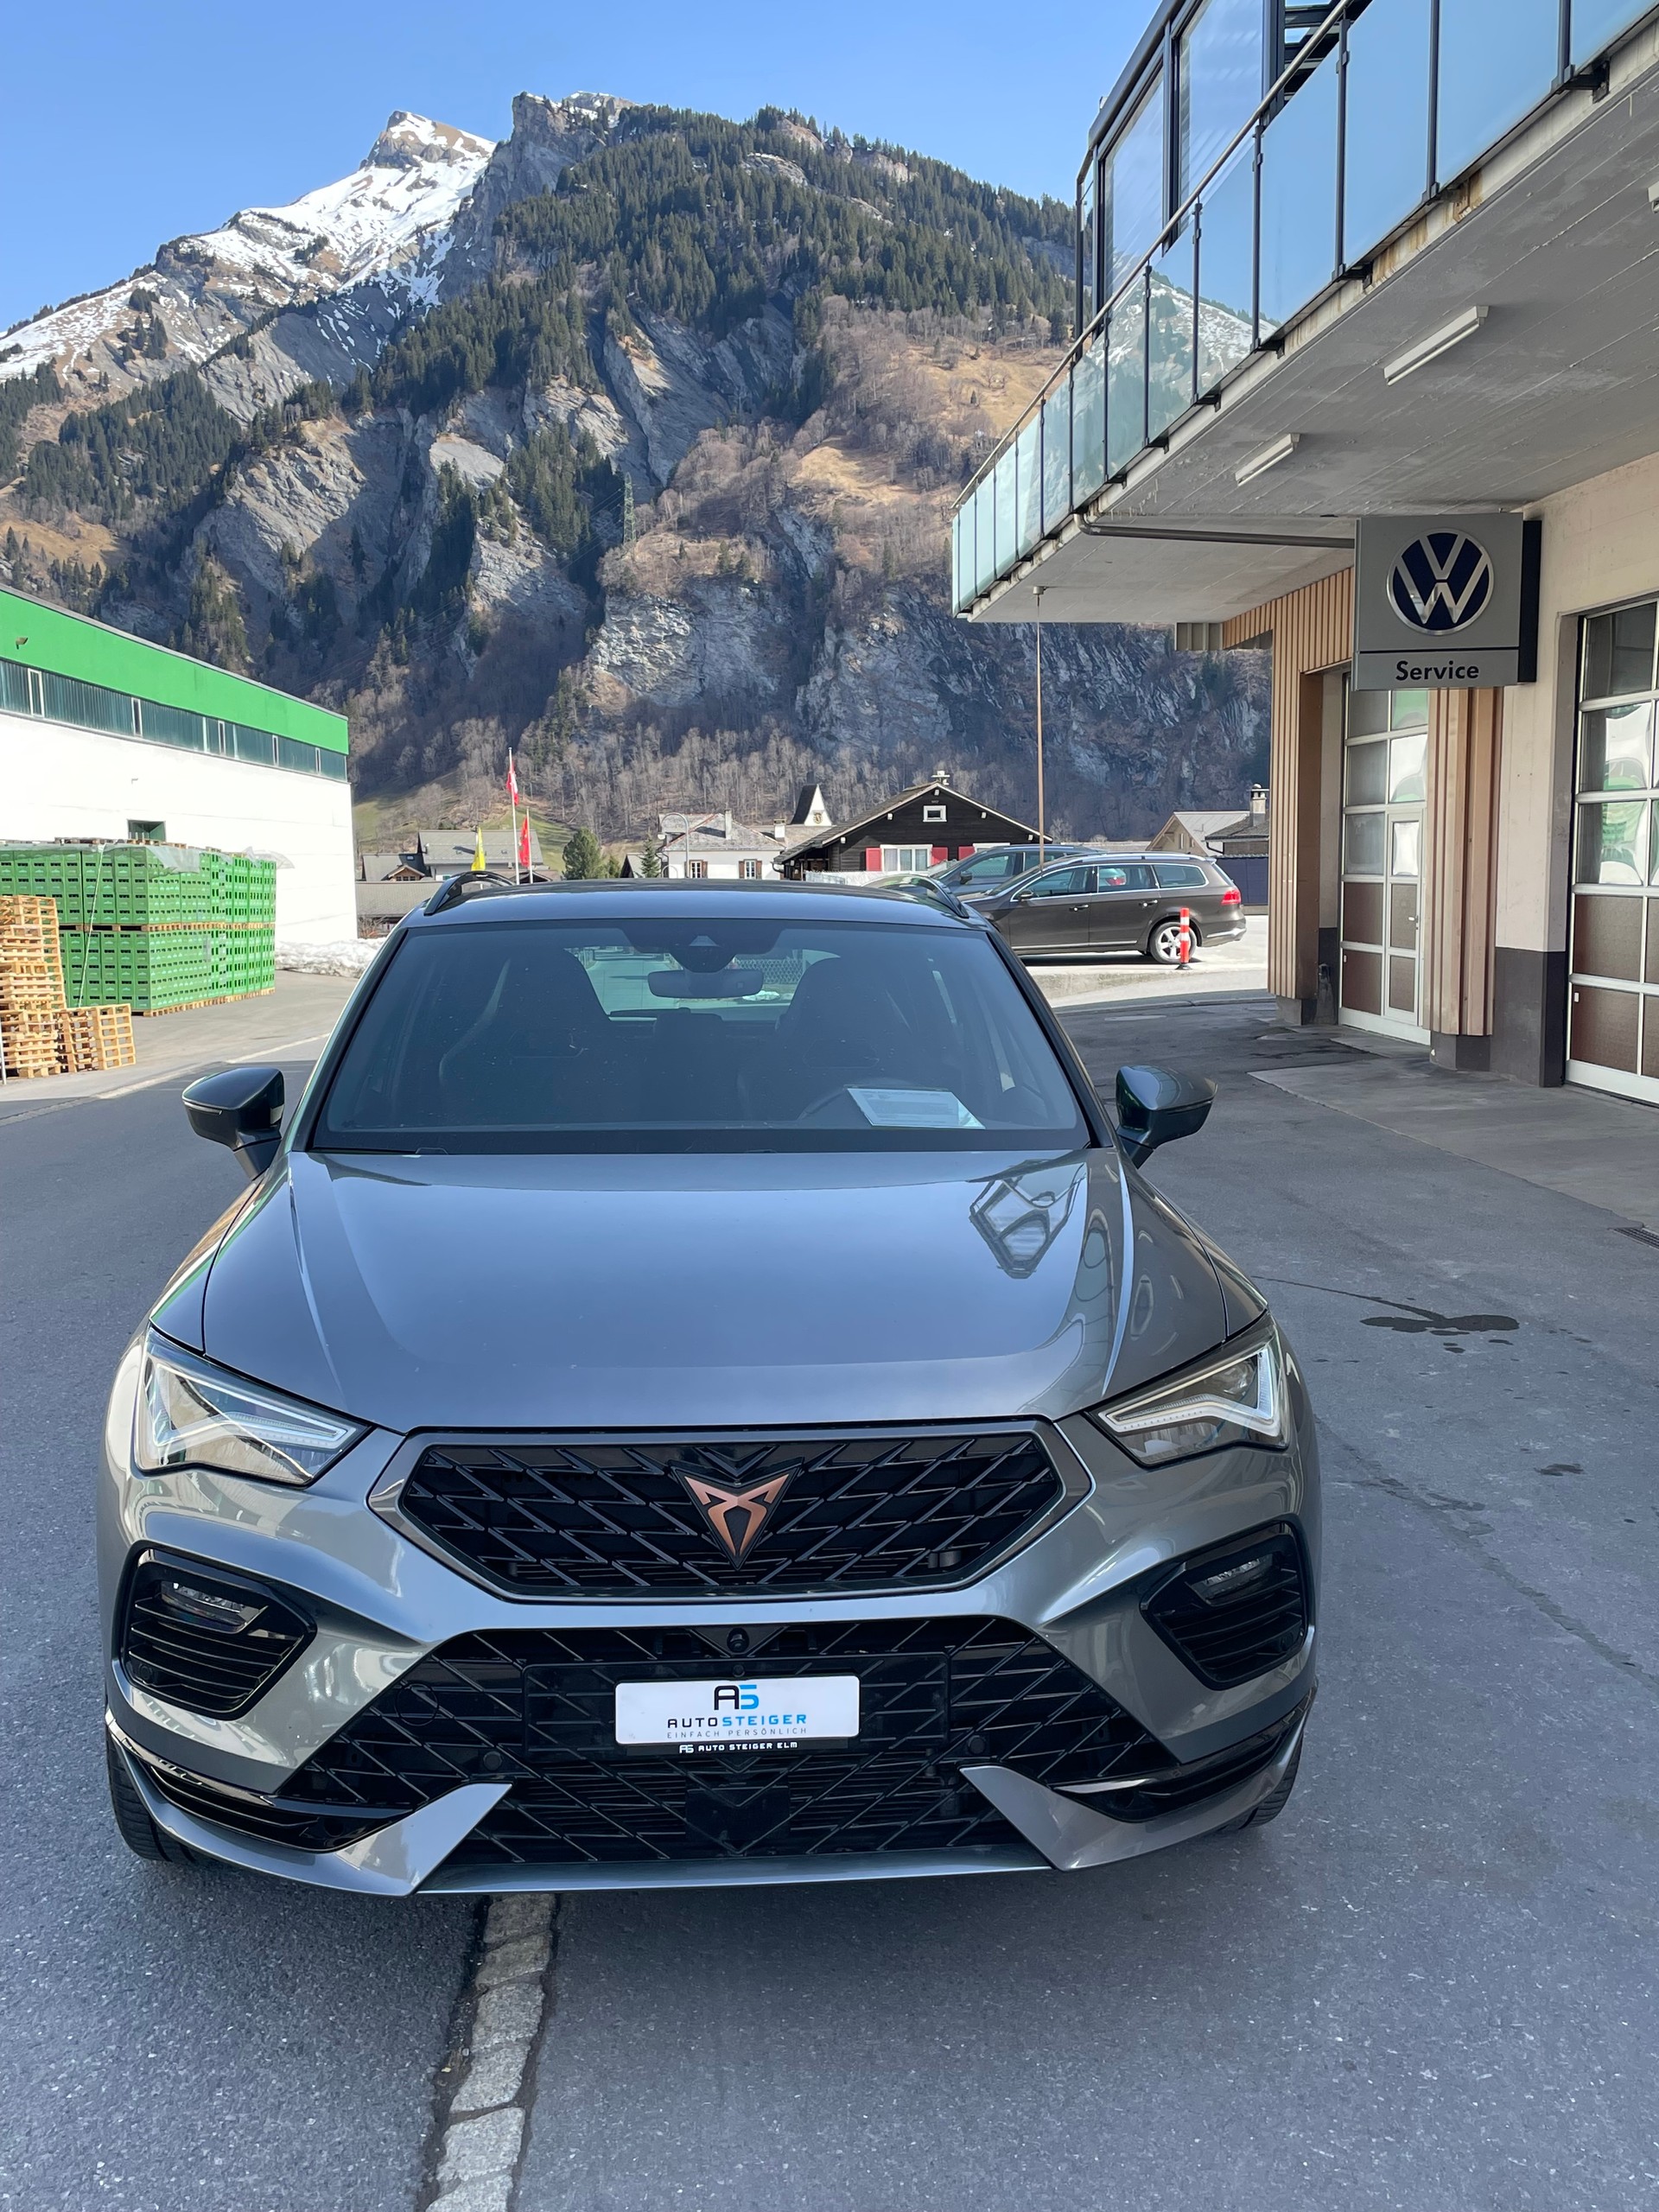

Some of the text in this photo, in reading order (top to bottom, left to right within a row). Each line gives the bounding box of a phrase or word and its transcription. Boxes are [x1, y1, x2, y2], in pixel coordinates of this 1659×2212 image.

[1389, 531, 1492, 632] VW
[1395, 660, 1479, 681] Service
[714, 1684, 760, 1710] AS
[667, 1727, 807, 1738] EINFACH PERSÖNLICH
